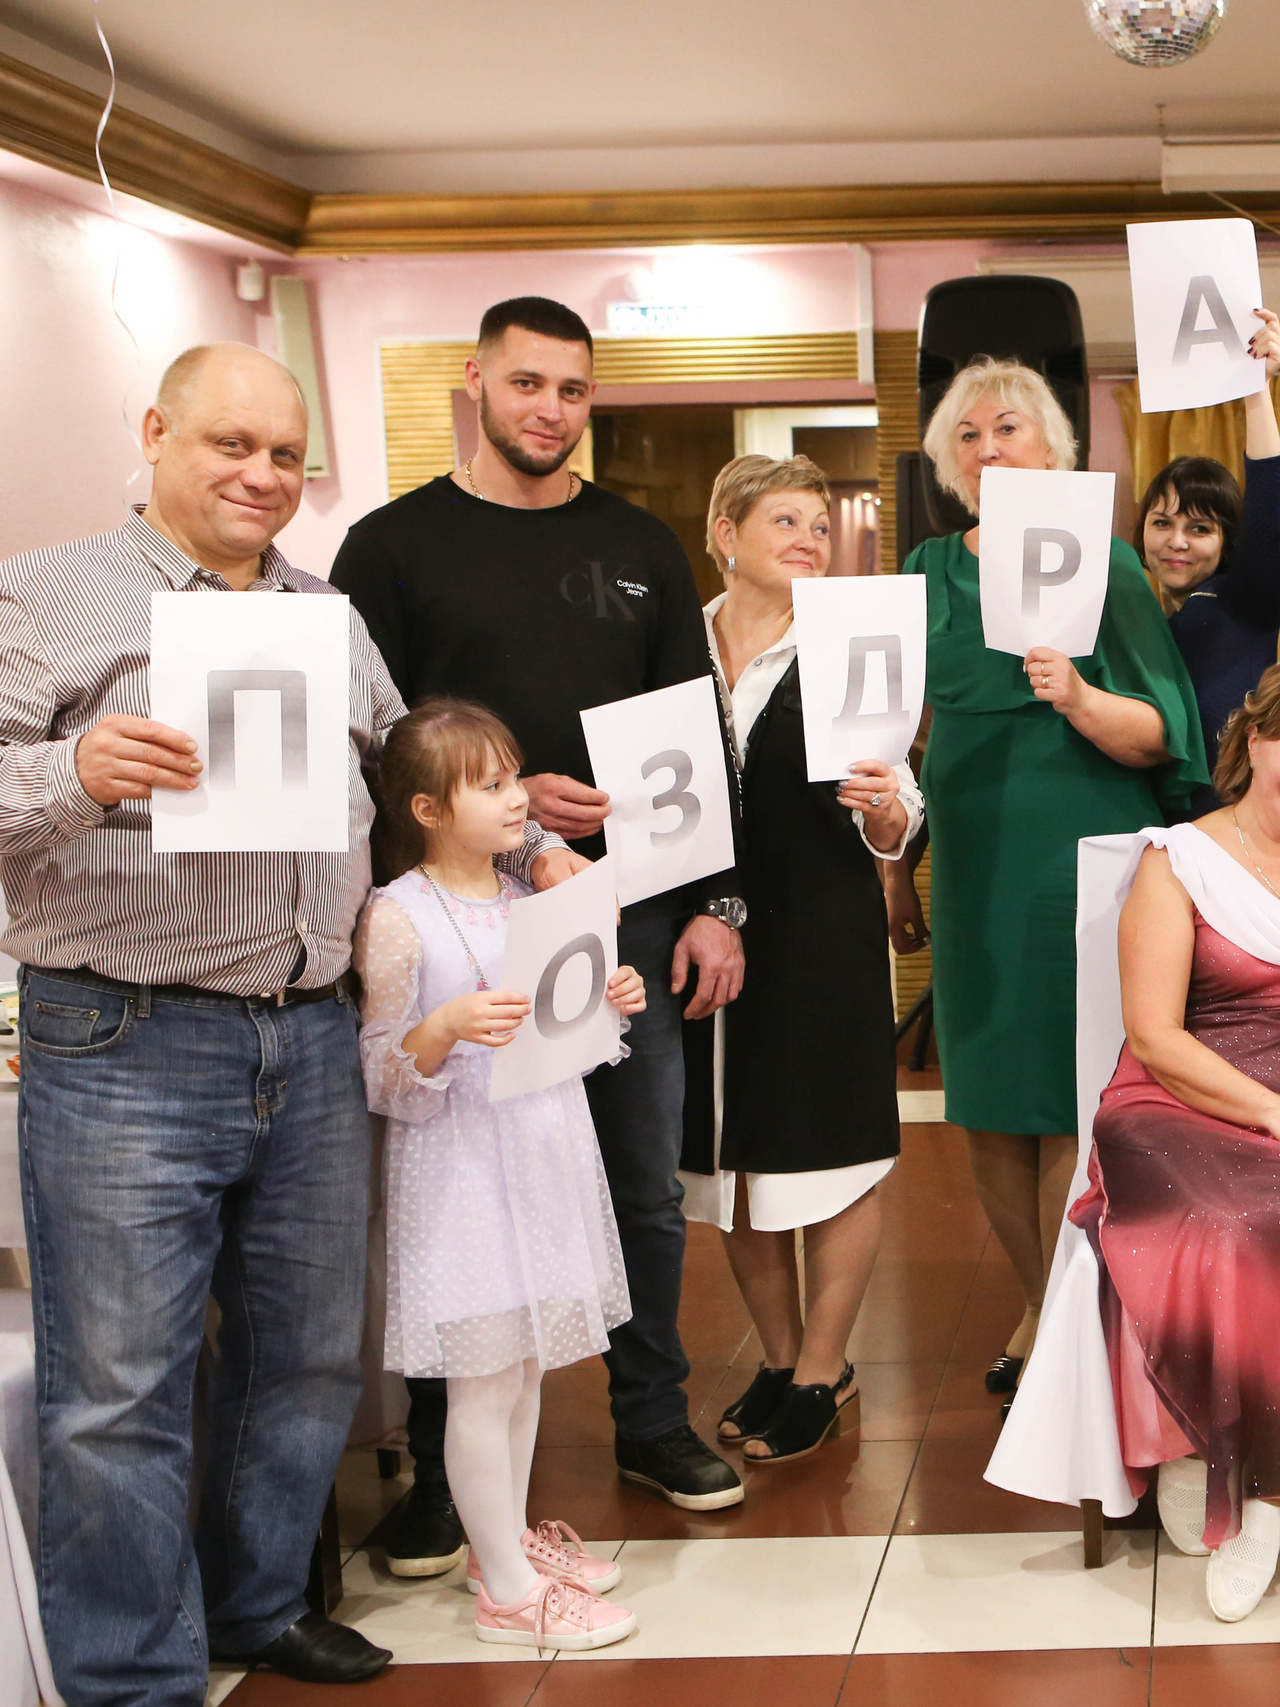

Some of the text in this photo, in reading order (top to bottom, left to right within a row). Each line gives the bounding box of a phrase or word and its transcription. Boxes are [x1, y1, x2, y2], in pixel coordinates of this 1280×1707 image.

[1171, 275, 1250, 367] А
[617, 580, 637, 589] Calvin
[626, 588, 643, 597] Jeans
[1021, 527, 1082, 617] Р
[207, 670, 308, 791] П
[832, 635, 909, 732] Д
[641, 749, 702, 850] З
[534, 933, 606, 1041] О
